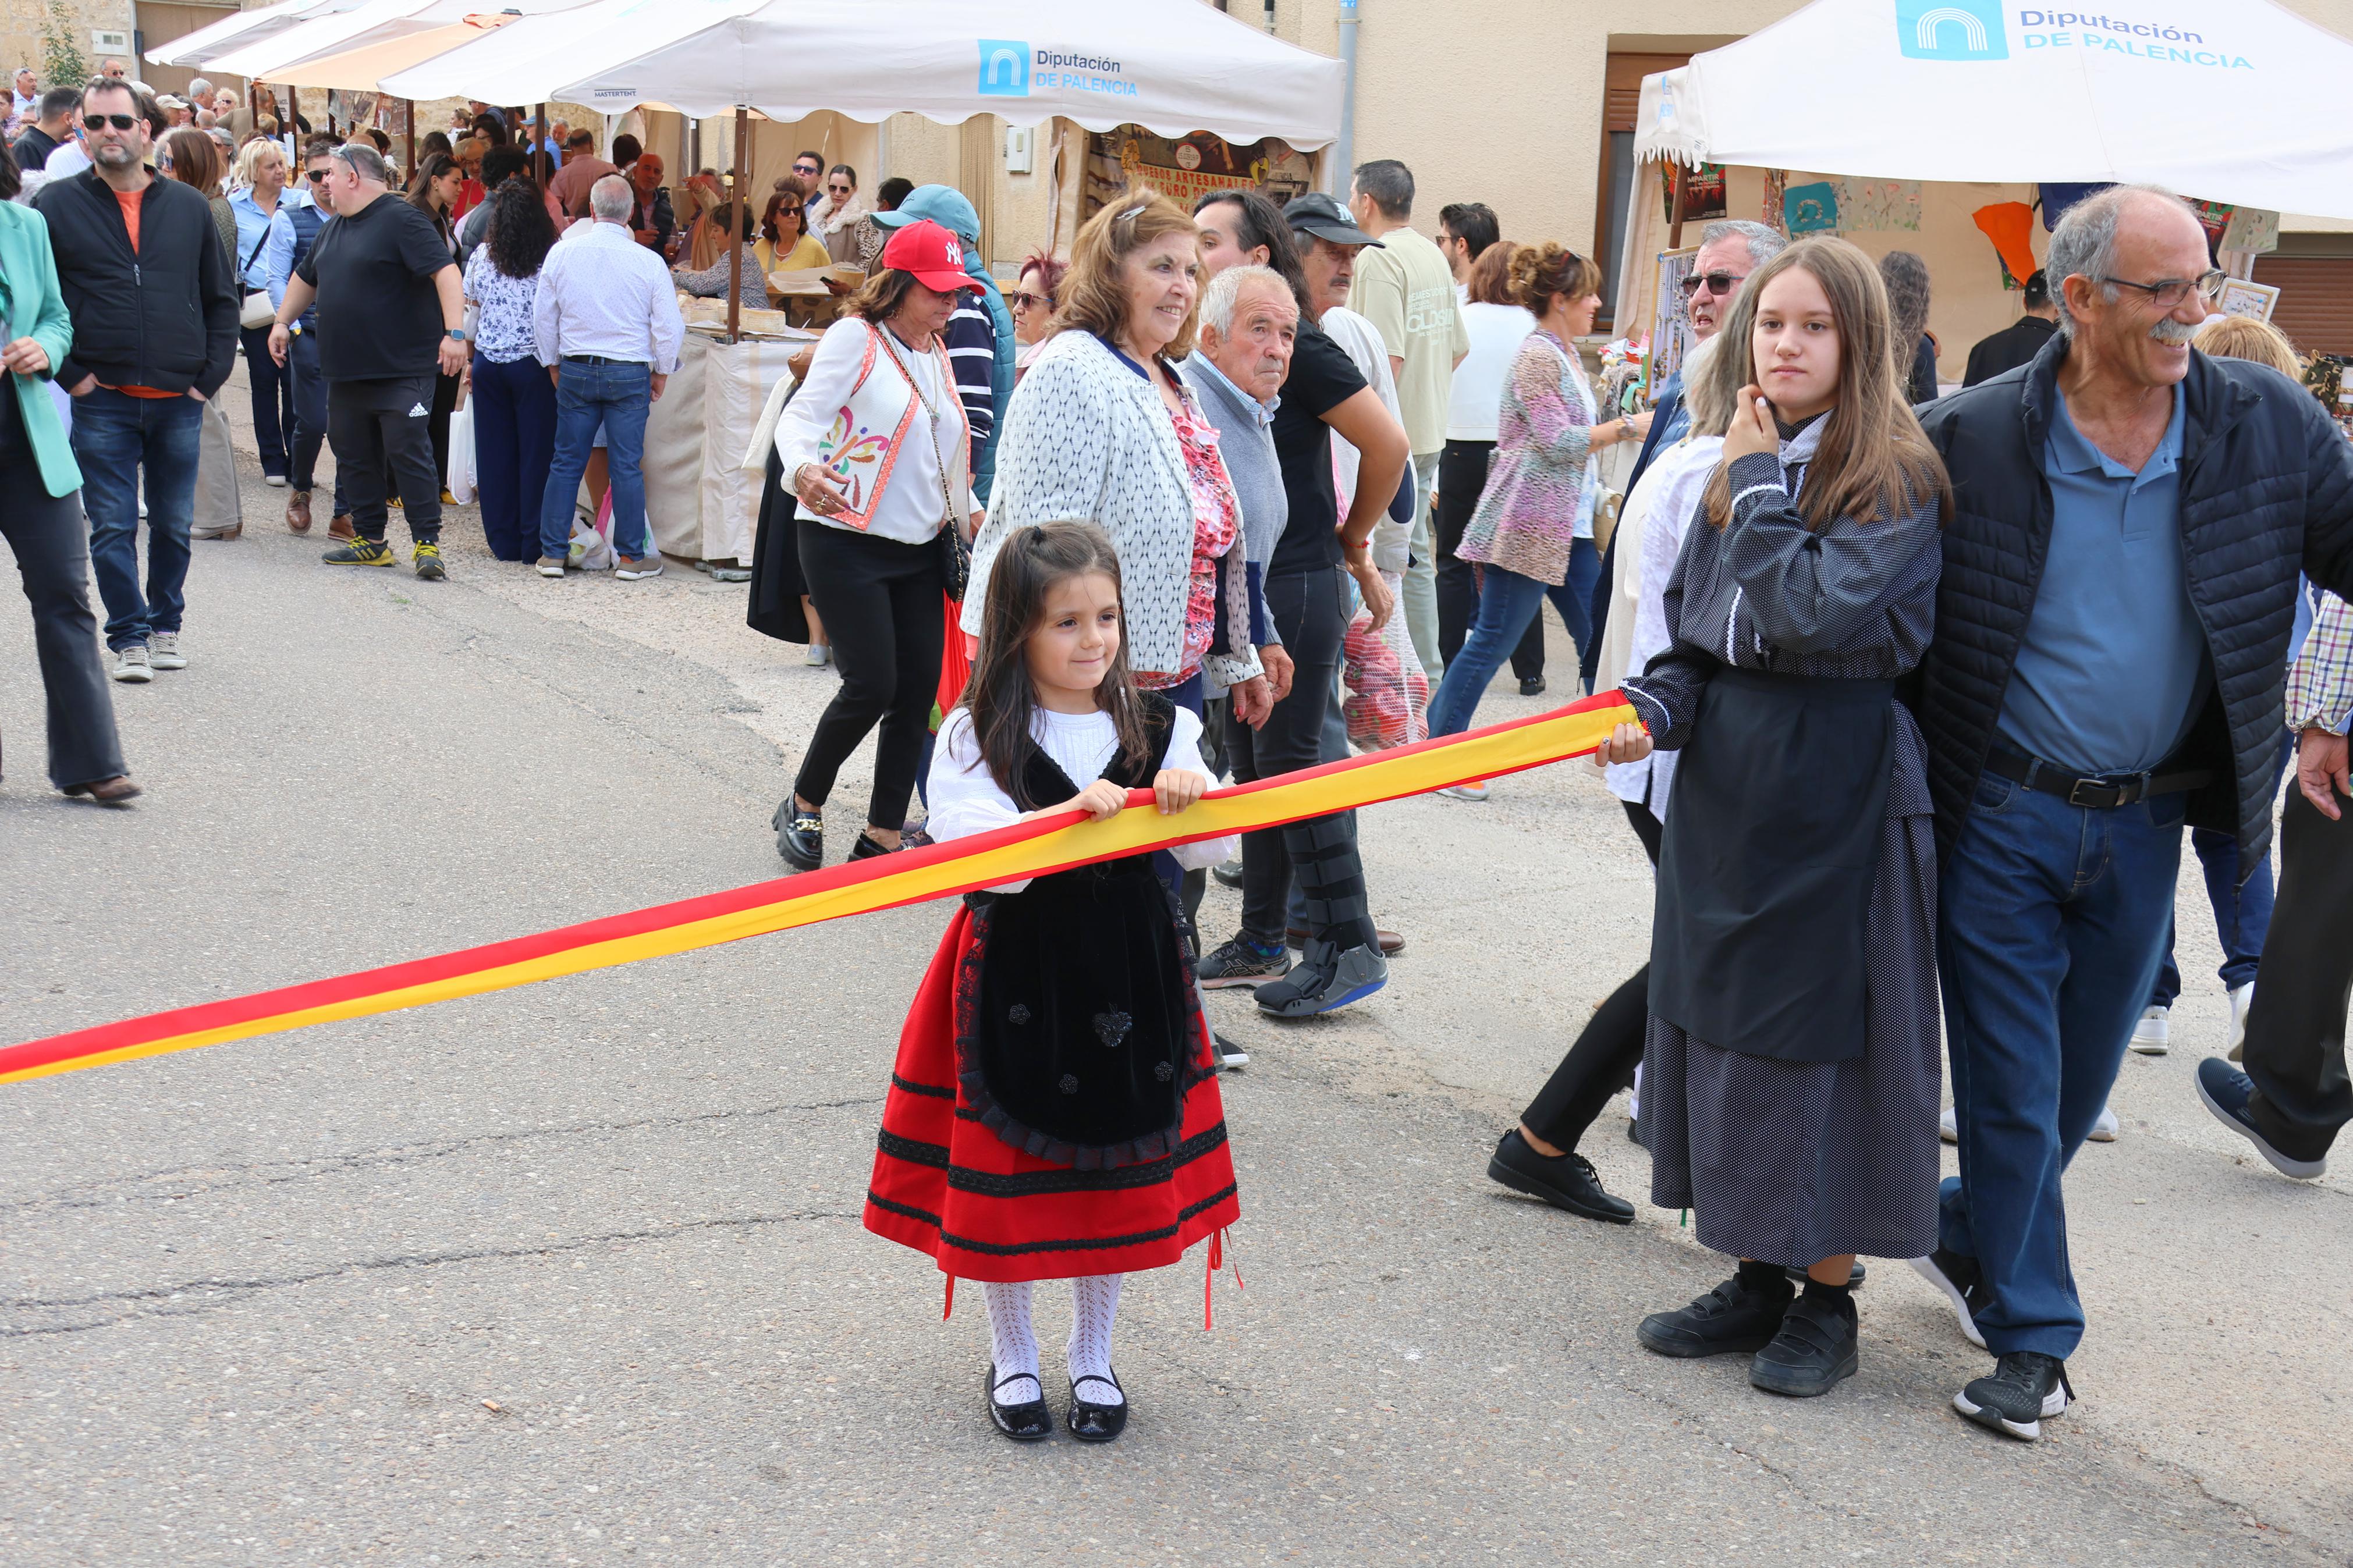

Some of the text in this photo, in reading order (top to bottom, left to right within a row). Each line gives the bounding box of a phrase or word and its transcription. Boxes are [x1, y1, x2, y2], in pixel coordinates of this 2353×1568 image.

[2020, 10, 2204, 44] Diputación
[1037, 50, 1120, 73] Diputación
[2024, 32, 2256, 70] DE PALENCIA
[1035, 72, 1138, 97] DE PALENCIA
[945, 241, 962, 265] NY
